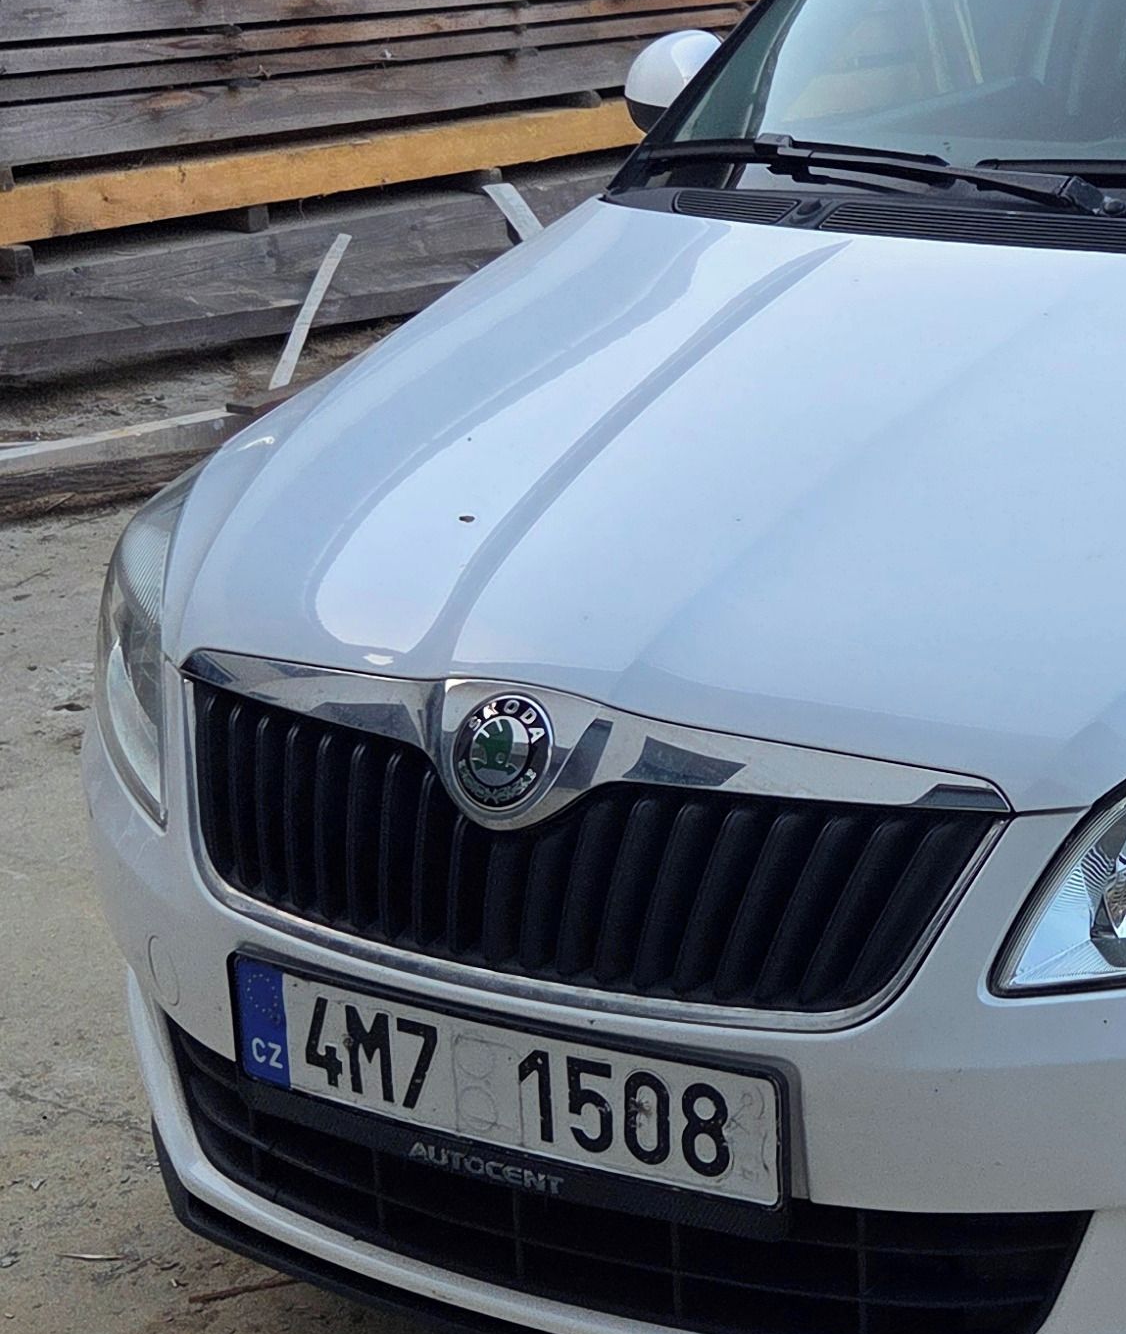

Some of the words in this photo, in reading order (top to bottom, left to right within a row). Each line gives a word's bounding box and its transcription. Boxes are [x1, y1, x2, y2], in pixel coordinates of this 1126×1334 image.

[251, 1037, 284, 1069] CZ
[305, 996, 439, 1110] 4M7
[517, 1049, 732, 1178] 1508
